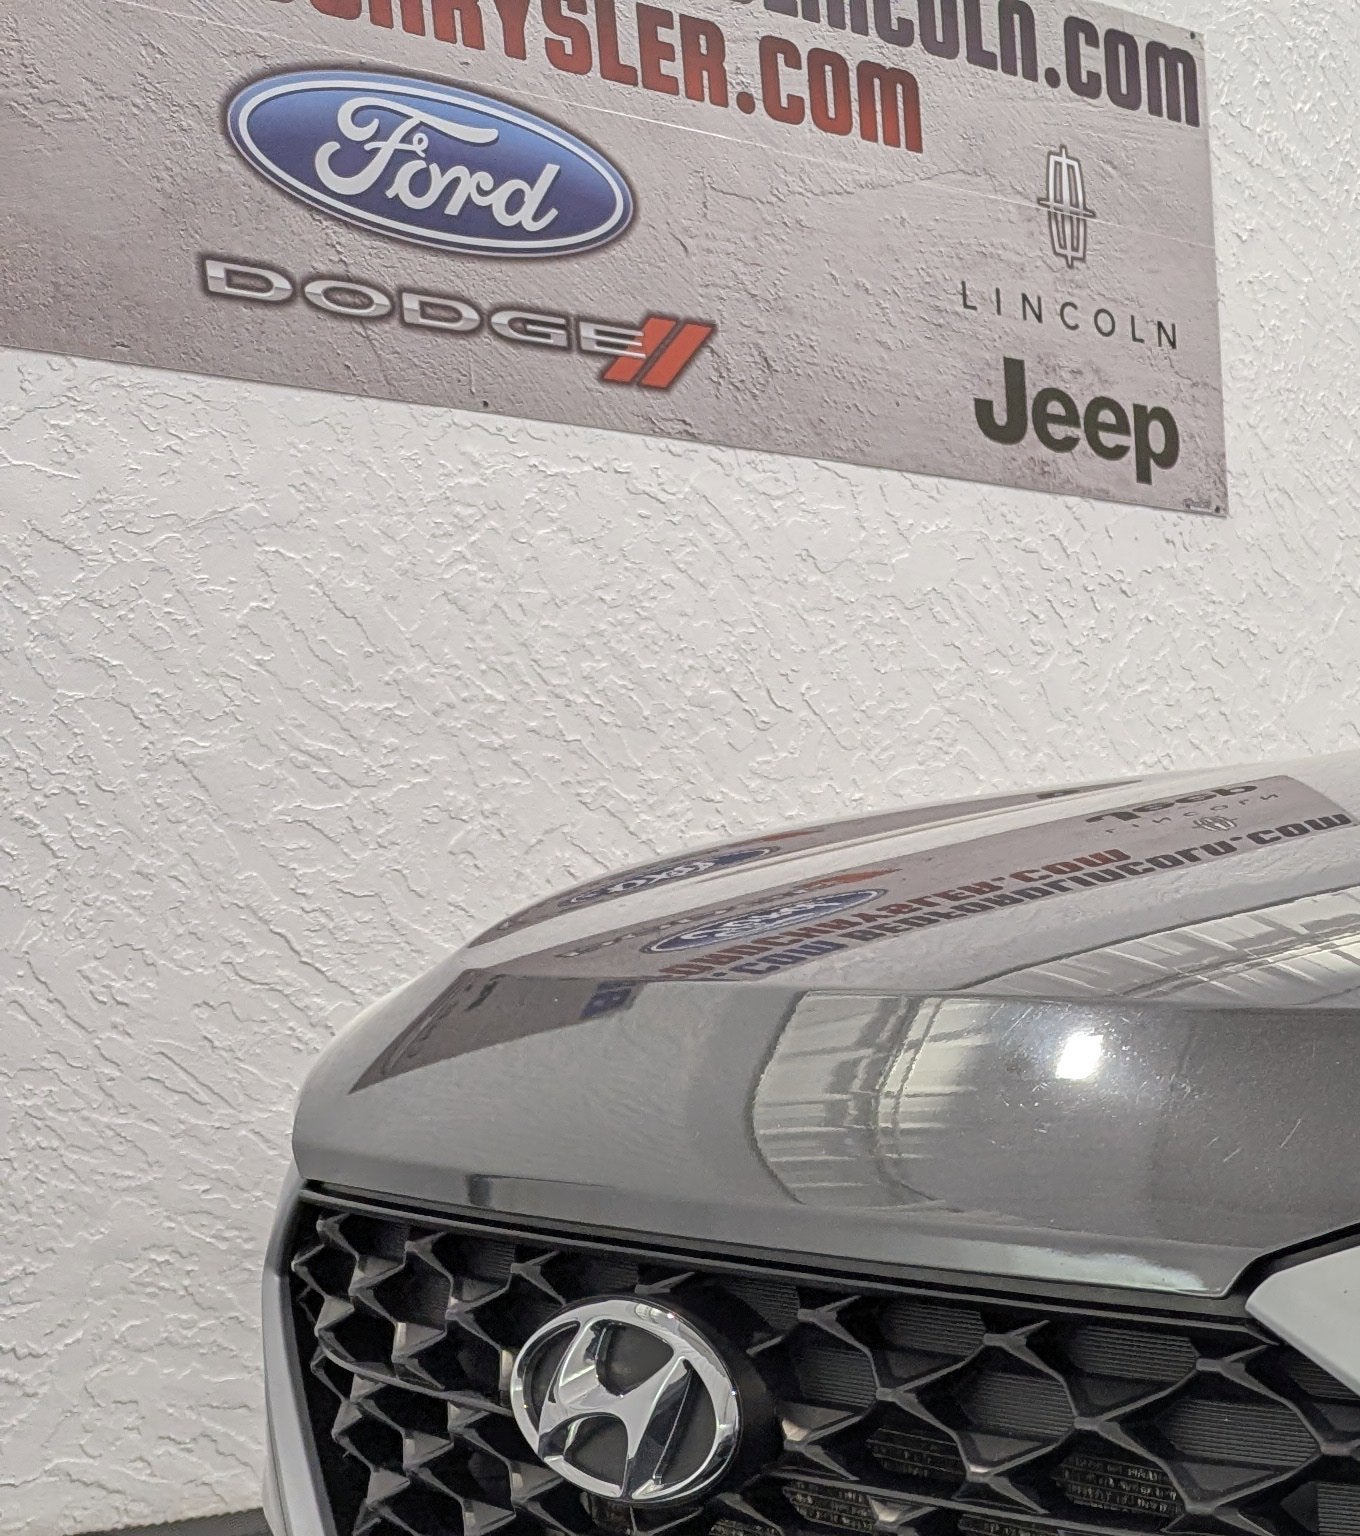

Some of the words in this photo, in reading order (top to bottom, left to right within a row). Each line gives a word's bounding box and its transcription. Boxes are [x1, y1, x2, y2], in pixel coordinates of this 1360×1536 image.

[307, 0, 924, 154] RYSLER.COM
[762, 0, 1201, 128] COLN.COM
[314, 96, 562, 232] Ford
[203, 258, 647, 361] DODGE
[961, 280, 1177, 350] LINCOLN
[973, 355, 1180, 486] Jeep
